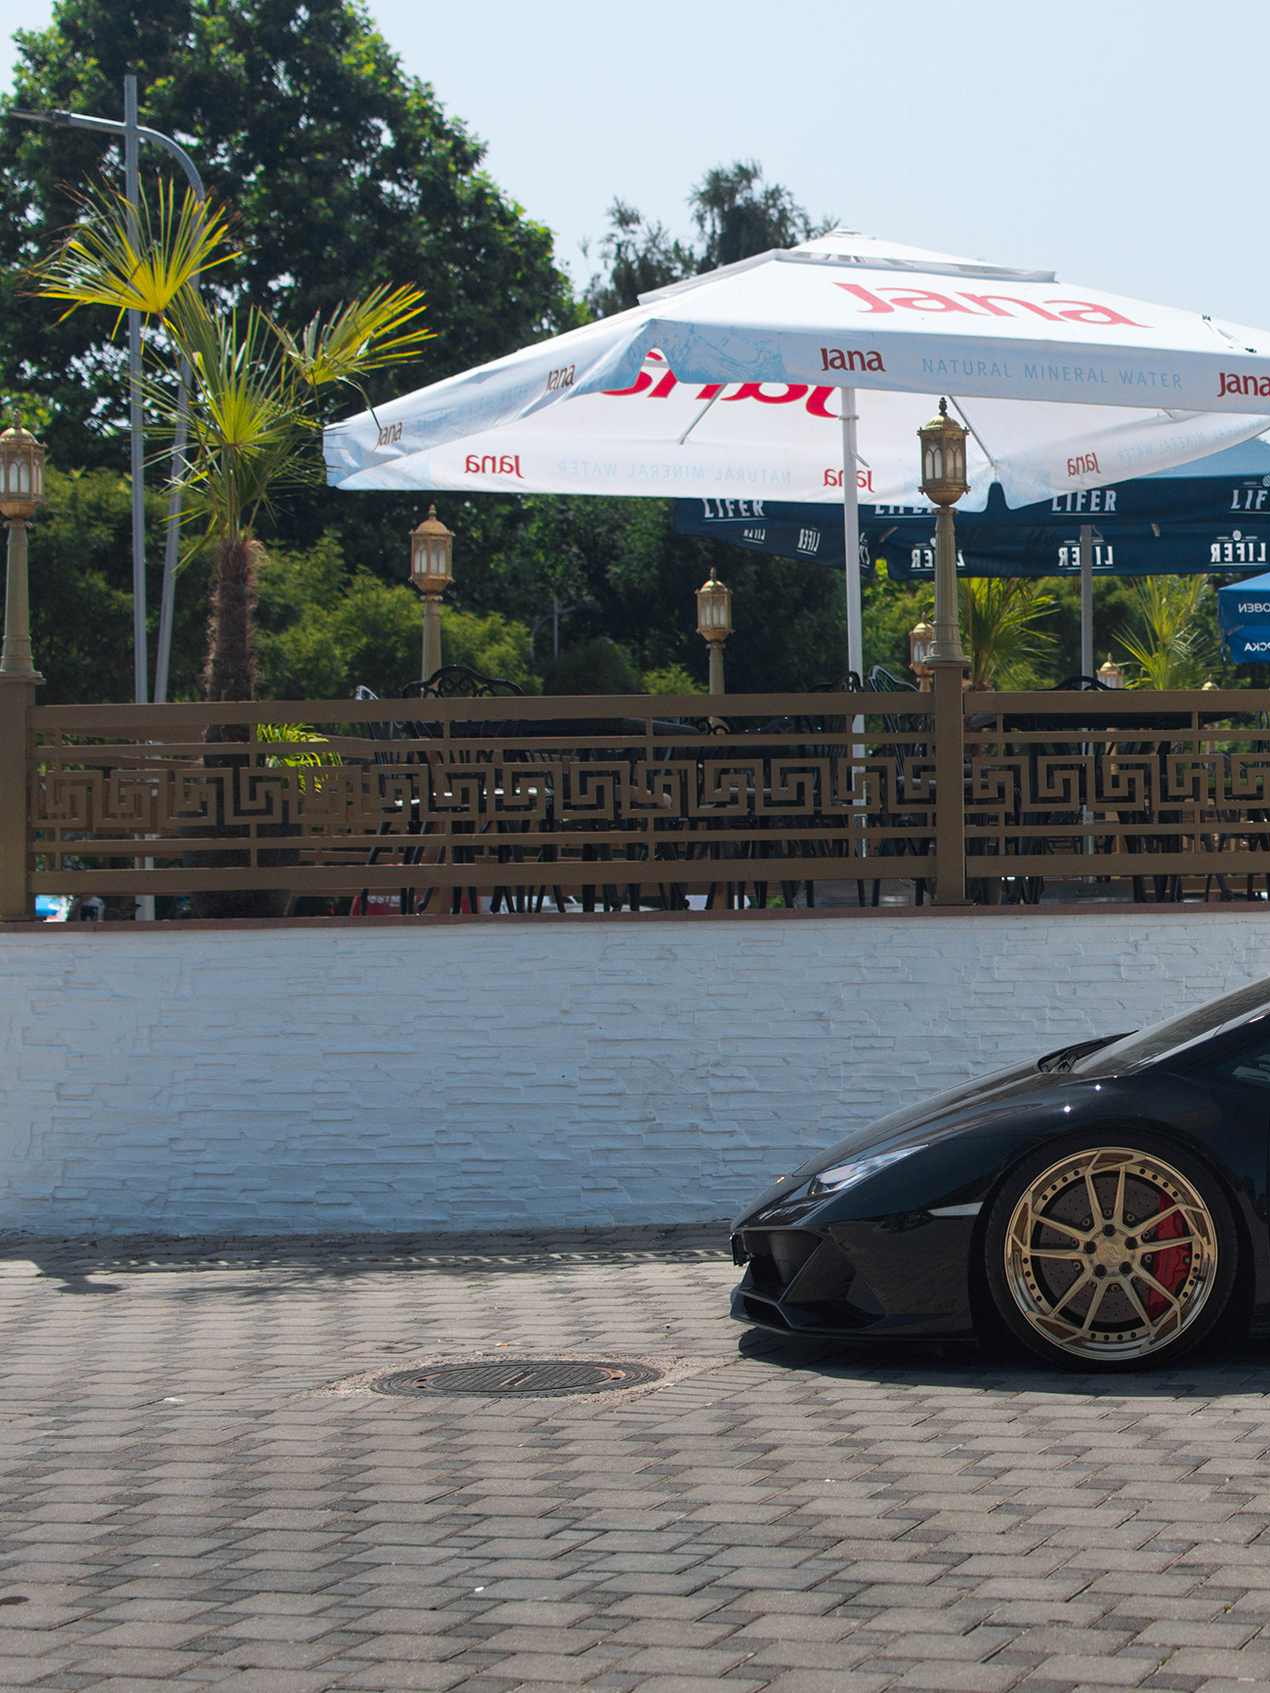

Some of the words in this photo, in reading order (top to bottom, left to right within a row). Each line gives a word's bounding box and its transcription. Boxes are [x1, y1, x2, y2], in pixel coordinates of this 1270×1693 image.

[922, 358, 1013, 378] NATURAL
[1024, 363, 1108, 384] MINERAL
[1119, 369, 1182, 389] WATER
[1051, 489, 1118, 512] LIFER
